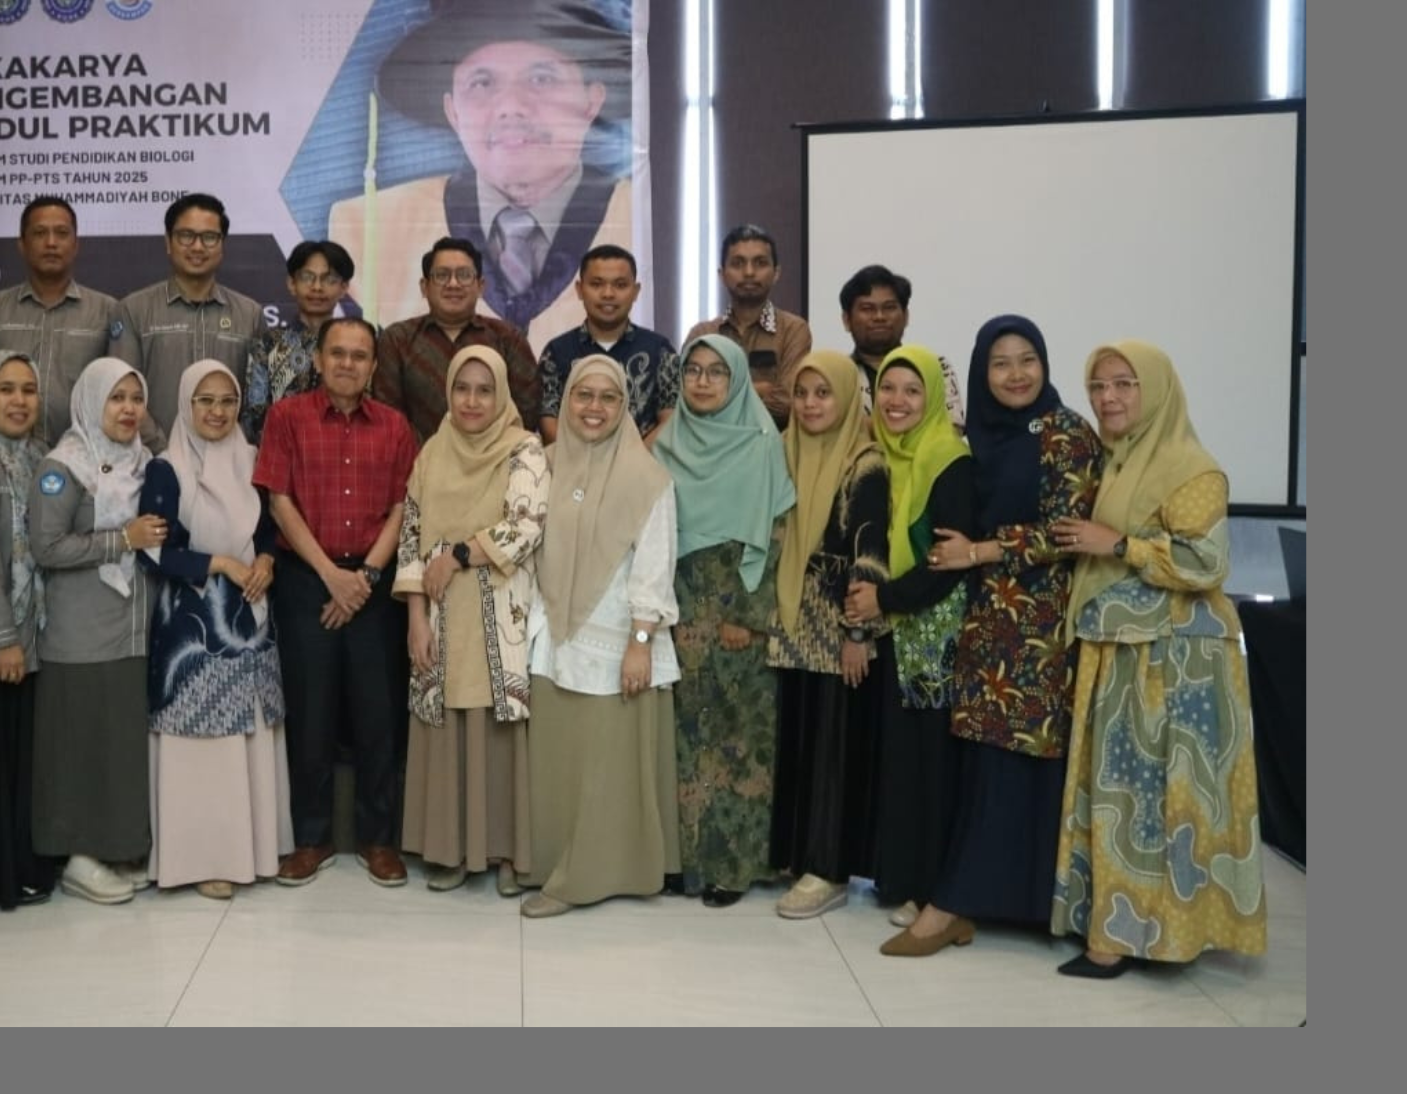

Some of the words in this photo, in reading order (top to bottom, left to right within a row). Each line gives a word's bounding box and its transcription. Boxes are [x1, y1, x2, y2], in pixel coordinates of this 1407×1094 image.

[68, 111, 271, 139] PRAKTIKUM
[9, 153, 49, 166] STUDI
[52, 151, 137, 165] PENDIDIKAN
[139, 150, 195, 163] BIOLOGI
[9, 172, 60, 186] PP-PTS
[63, 171, 111, 185] TAHUN
[114, 170, 148, 184] 2025
